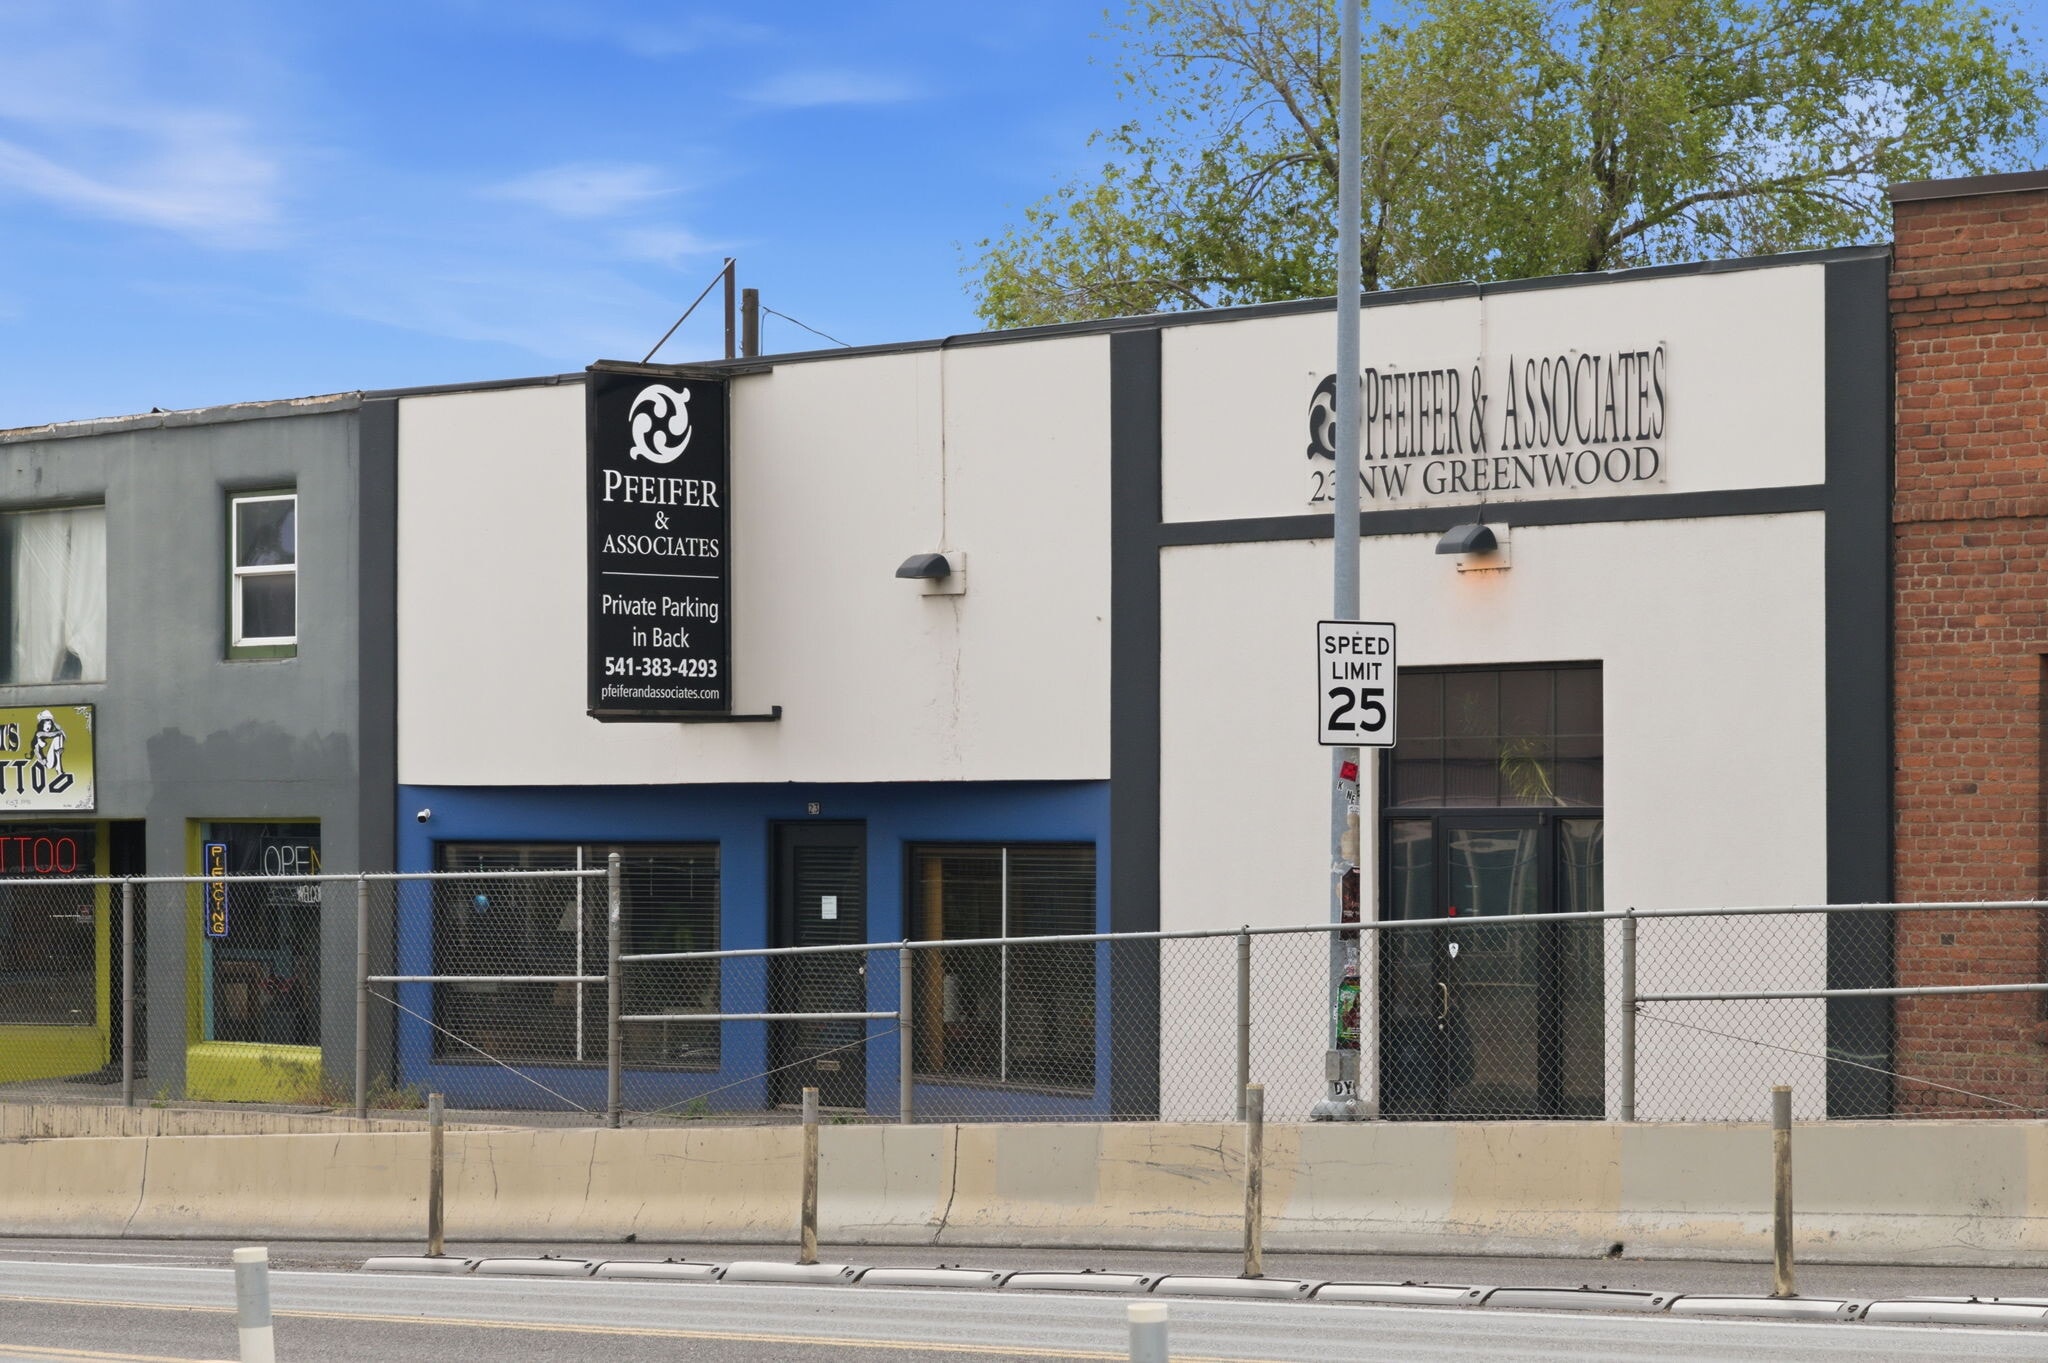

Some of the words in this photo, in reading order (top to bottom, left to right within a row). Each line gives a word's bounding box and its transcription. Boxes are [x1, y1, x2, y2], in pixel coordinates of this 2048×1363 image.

[1365, 367, 1463, 460] PFEIFER
[1469, 365, 1488, 454] &
[1501, 346, 1664, 451] ASSOCIATES
[1422, 446, 1660, 495] GREENWOOD
[602, 469, 719, 508] PFEIFER
[655, 511, 669, 529] &
[602, 534, 719, 557] ASSOCIATES
[602, 594, 656, 616] Private
[662, 596, 719, 623] Parking
[633, 626, 647, 647] in
[653, 627, 690, 648] Back
[1325, 636, 1390, 655] SPEED
[605, 657, 717, 677] 541-383-4293
[1332, 662, 1382, 680] LIMIT
[601, 684, 719, 700] pfeiferandassociates.com
[1328, 687, 1386, 732] 25
